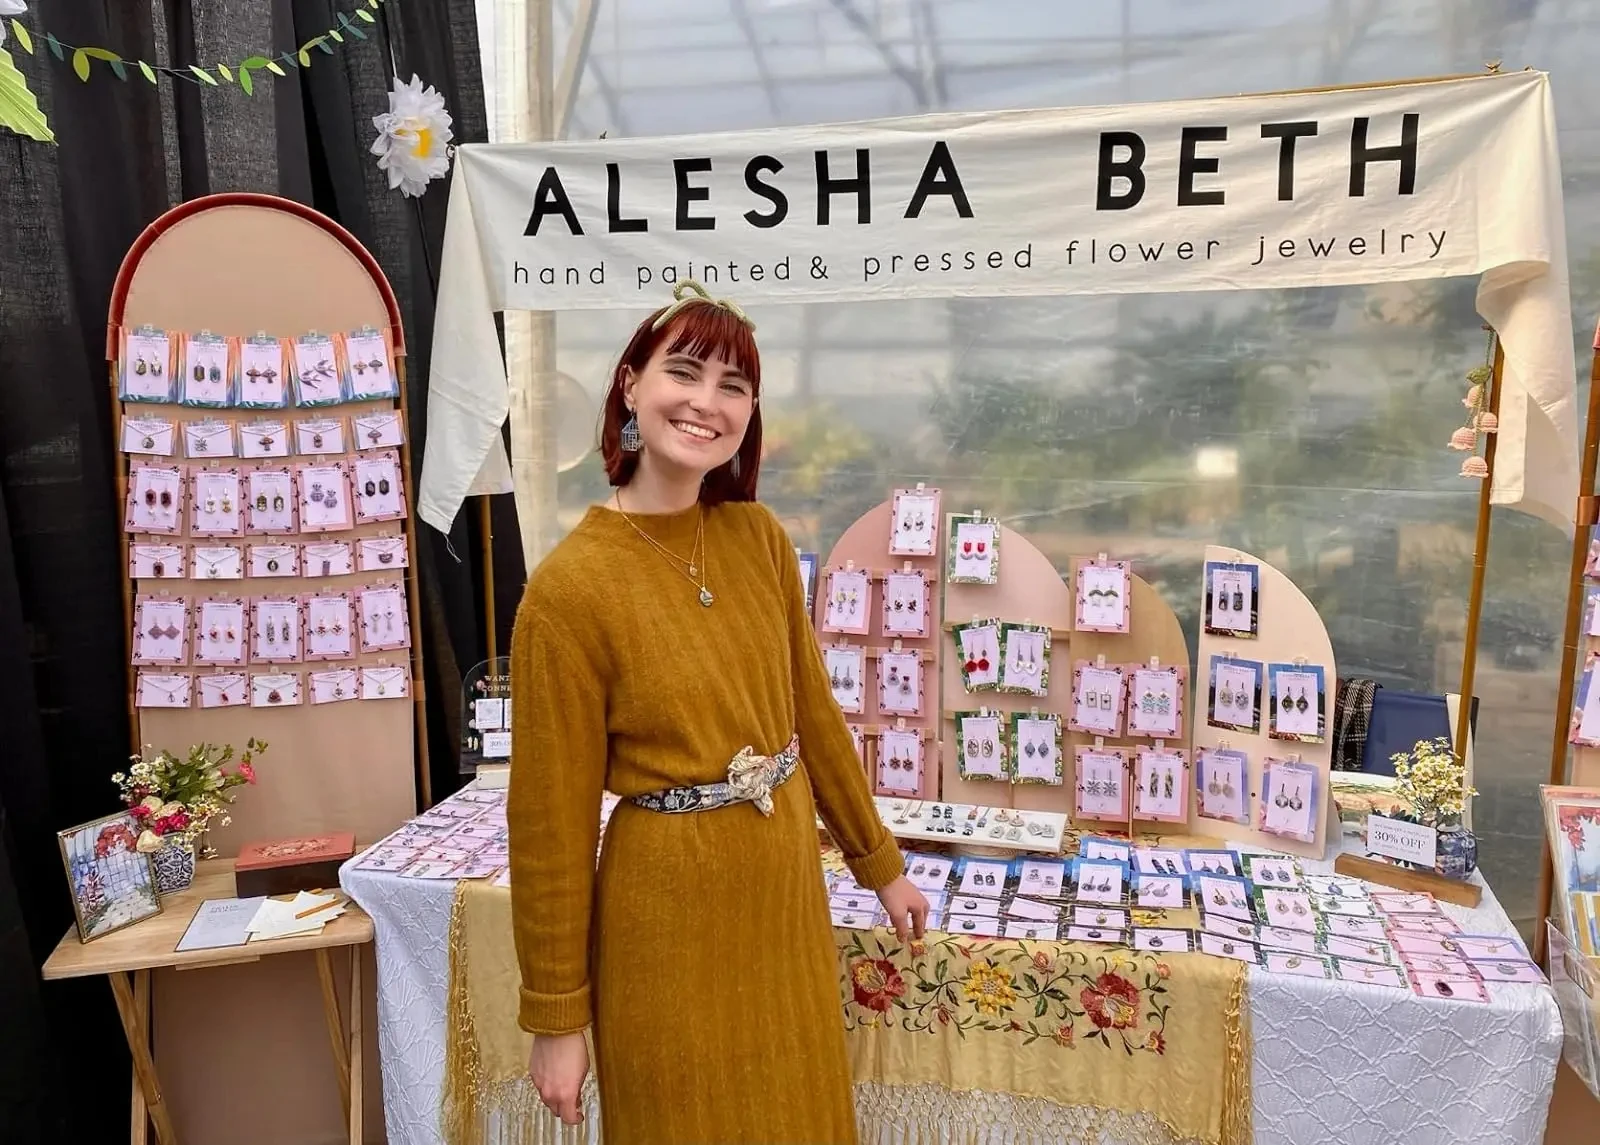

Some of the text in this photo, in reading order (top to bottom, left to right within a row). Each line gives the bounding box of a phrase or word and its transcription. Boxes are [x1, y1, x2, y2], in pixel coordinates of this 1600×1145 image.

[523, 113, 1420, 237] ALESHA BETH
[514, 228, 1446, 290] hand painted & pressed flower jewelry
[1374, 830, 1398, 845] 30%
[1400, 836, 1426, 849] OFF
